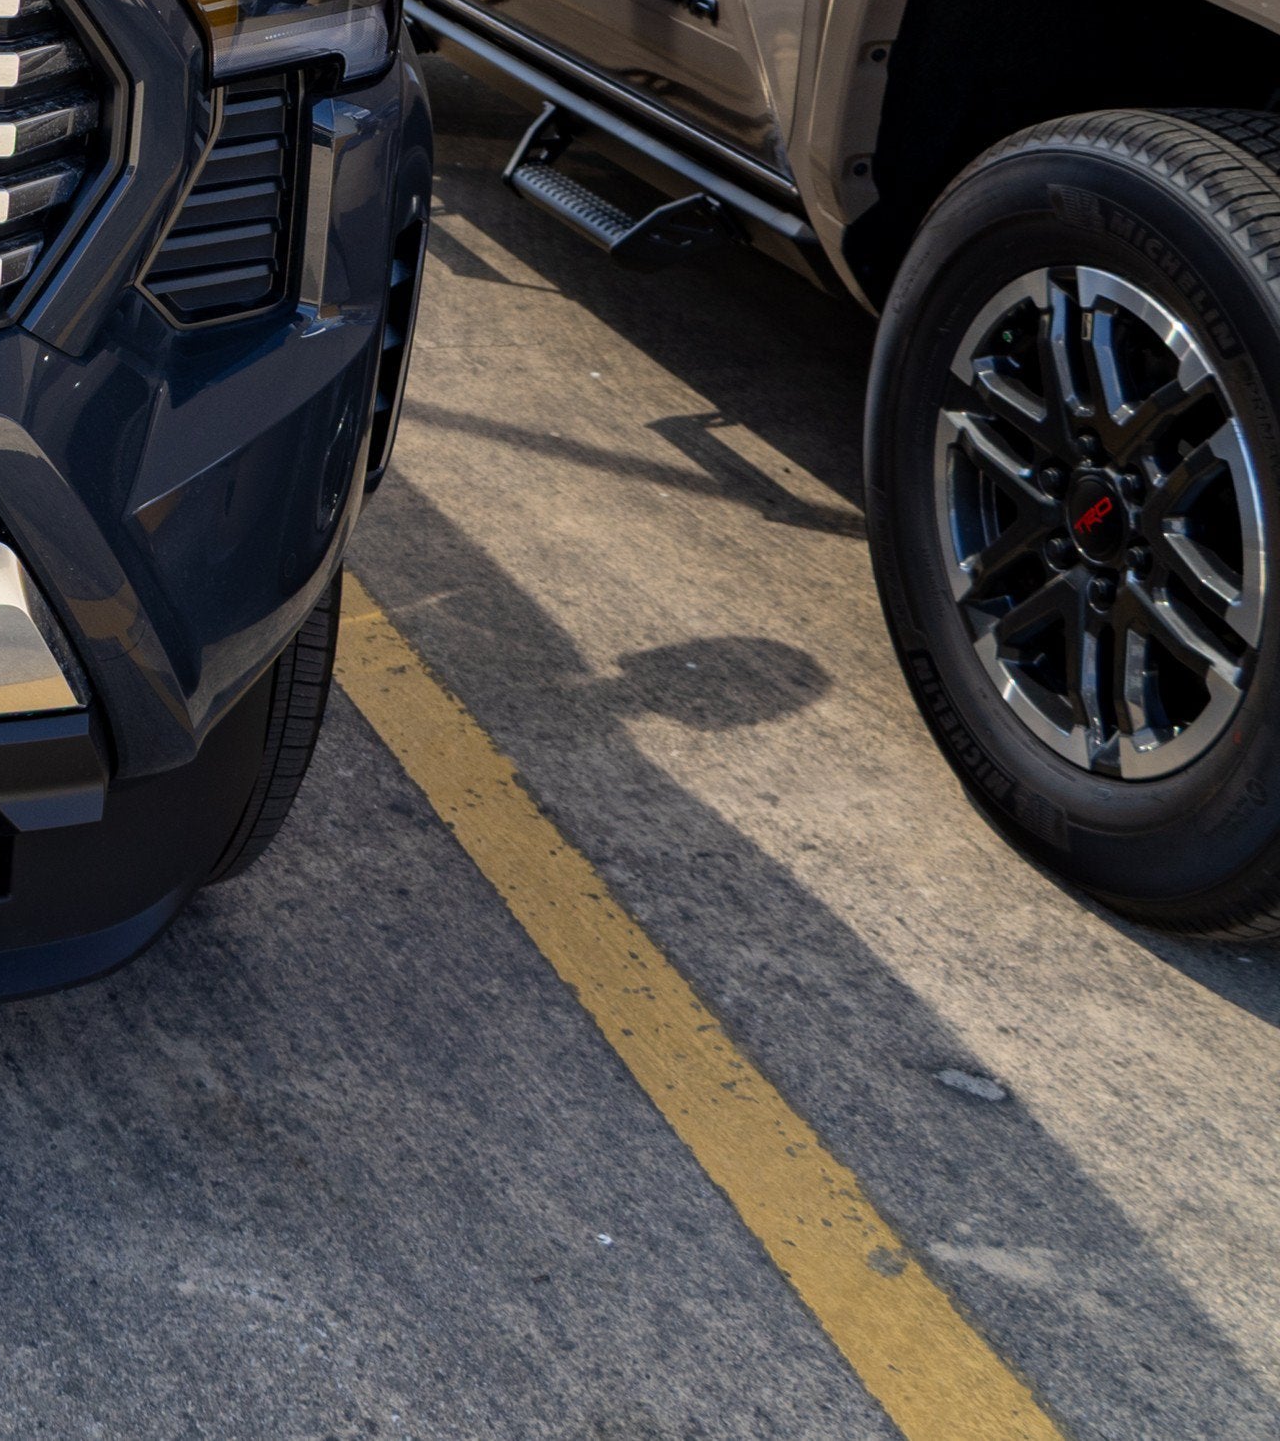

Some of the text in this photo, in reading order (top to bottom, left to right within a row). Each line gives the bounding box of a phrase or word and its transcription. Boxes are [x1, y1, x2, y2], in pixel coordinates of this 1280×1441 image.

[1109, 210, 1236, 350] MICHELIN
[1075, 496, 1113, 534] TRD
[913, 654, 1011, 800] MICHELIN
